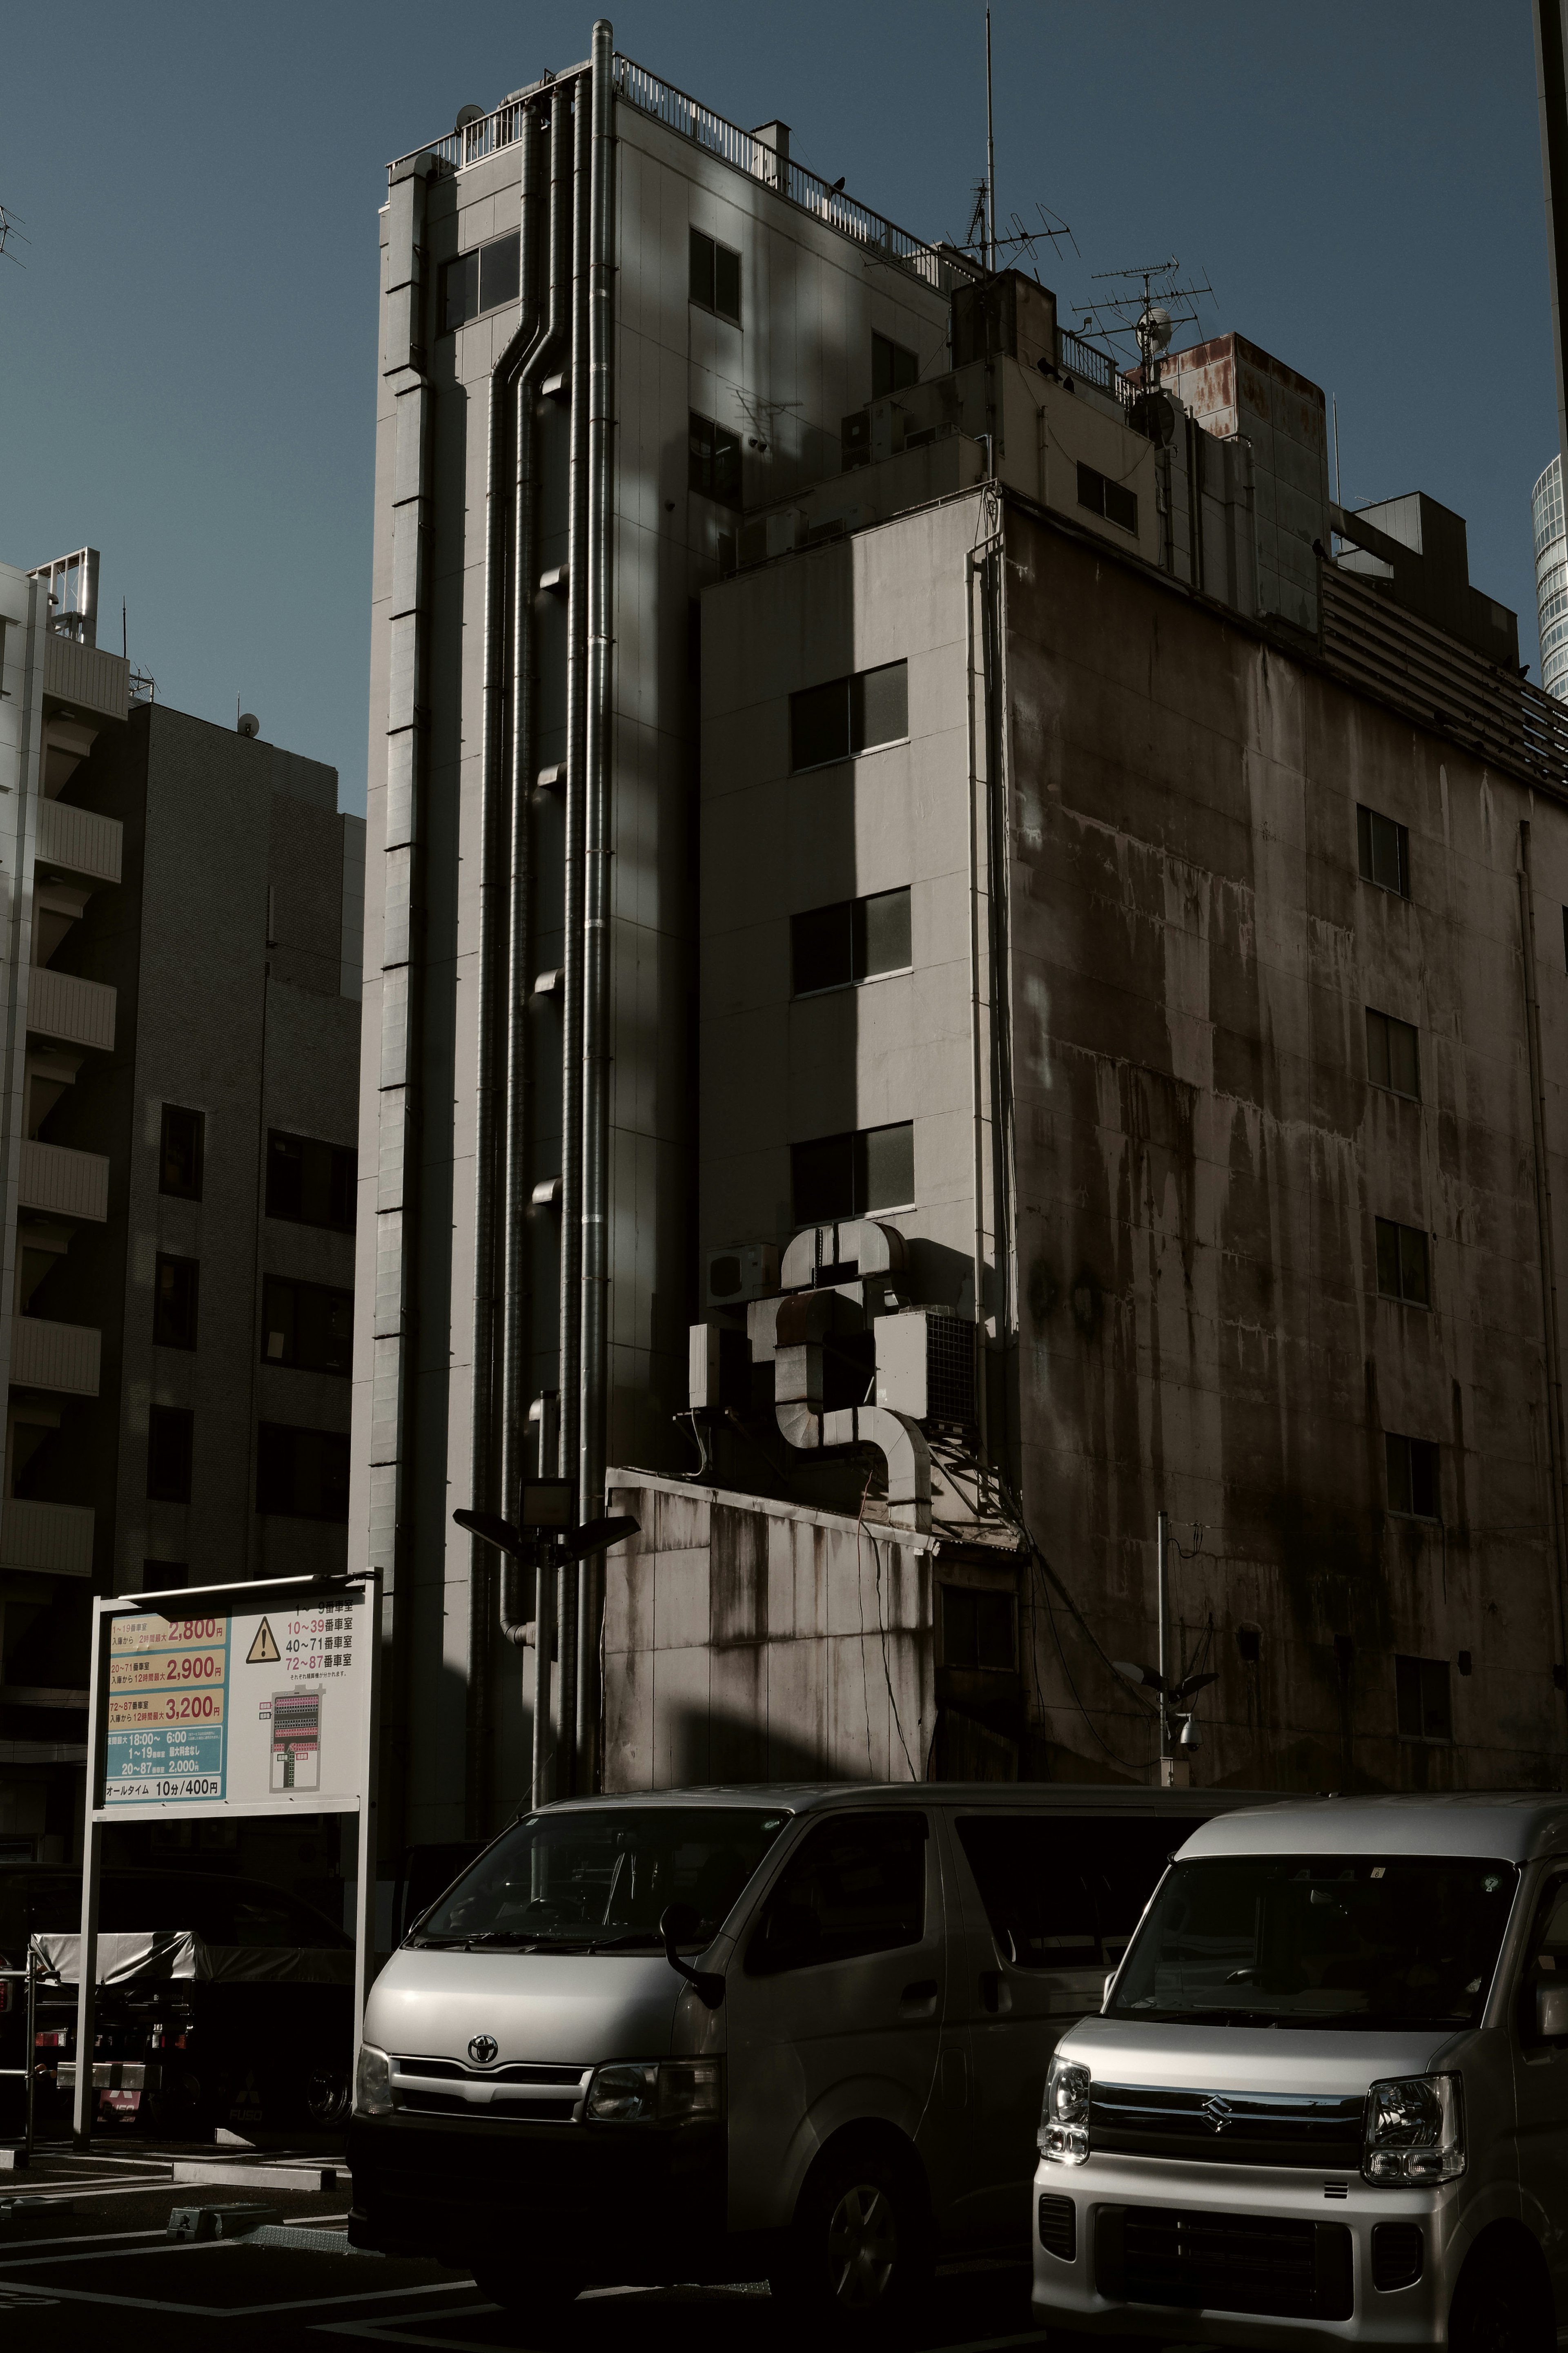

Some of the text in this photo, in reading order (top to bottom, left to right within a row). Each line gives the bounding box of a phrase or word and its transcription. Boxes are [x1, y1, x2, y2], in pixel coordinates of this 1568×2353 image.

[112, 1636, 134, 1645] 入庫から
[139, 1633, 167, 1643] 2時間最大
[111, 1656, 221, 1684] 入庫から 12時間最大 2,900円
[110, 1696, 220, 1723] 入庫から 12時間最大 3,200円
[107, 1785, 149, 1796] オールタイム
[103, 2104, 134, 2115] FUSO
[229, 2109, 263, 2121] FUSO
